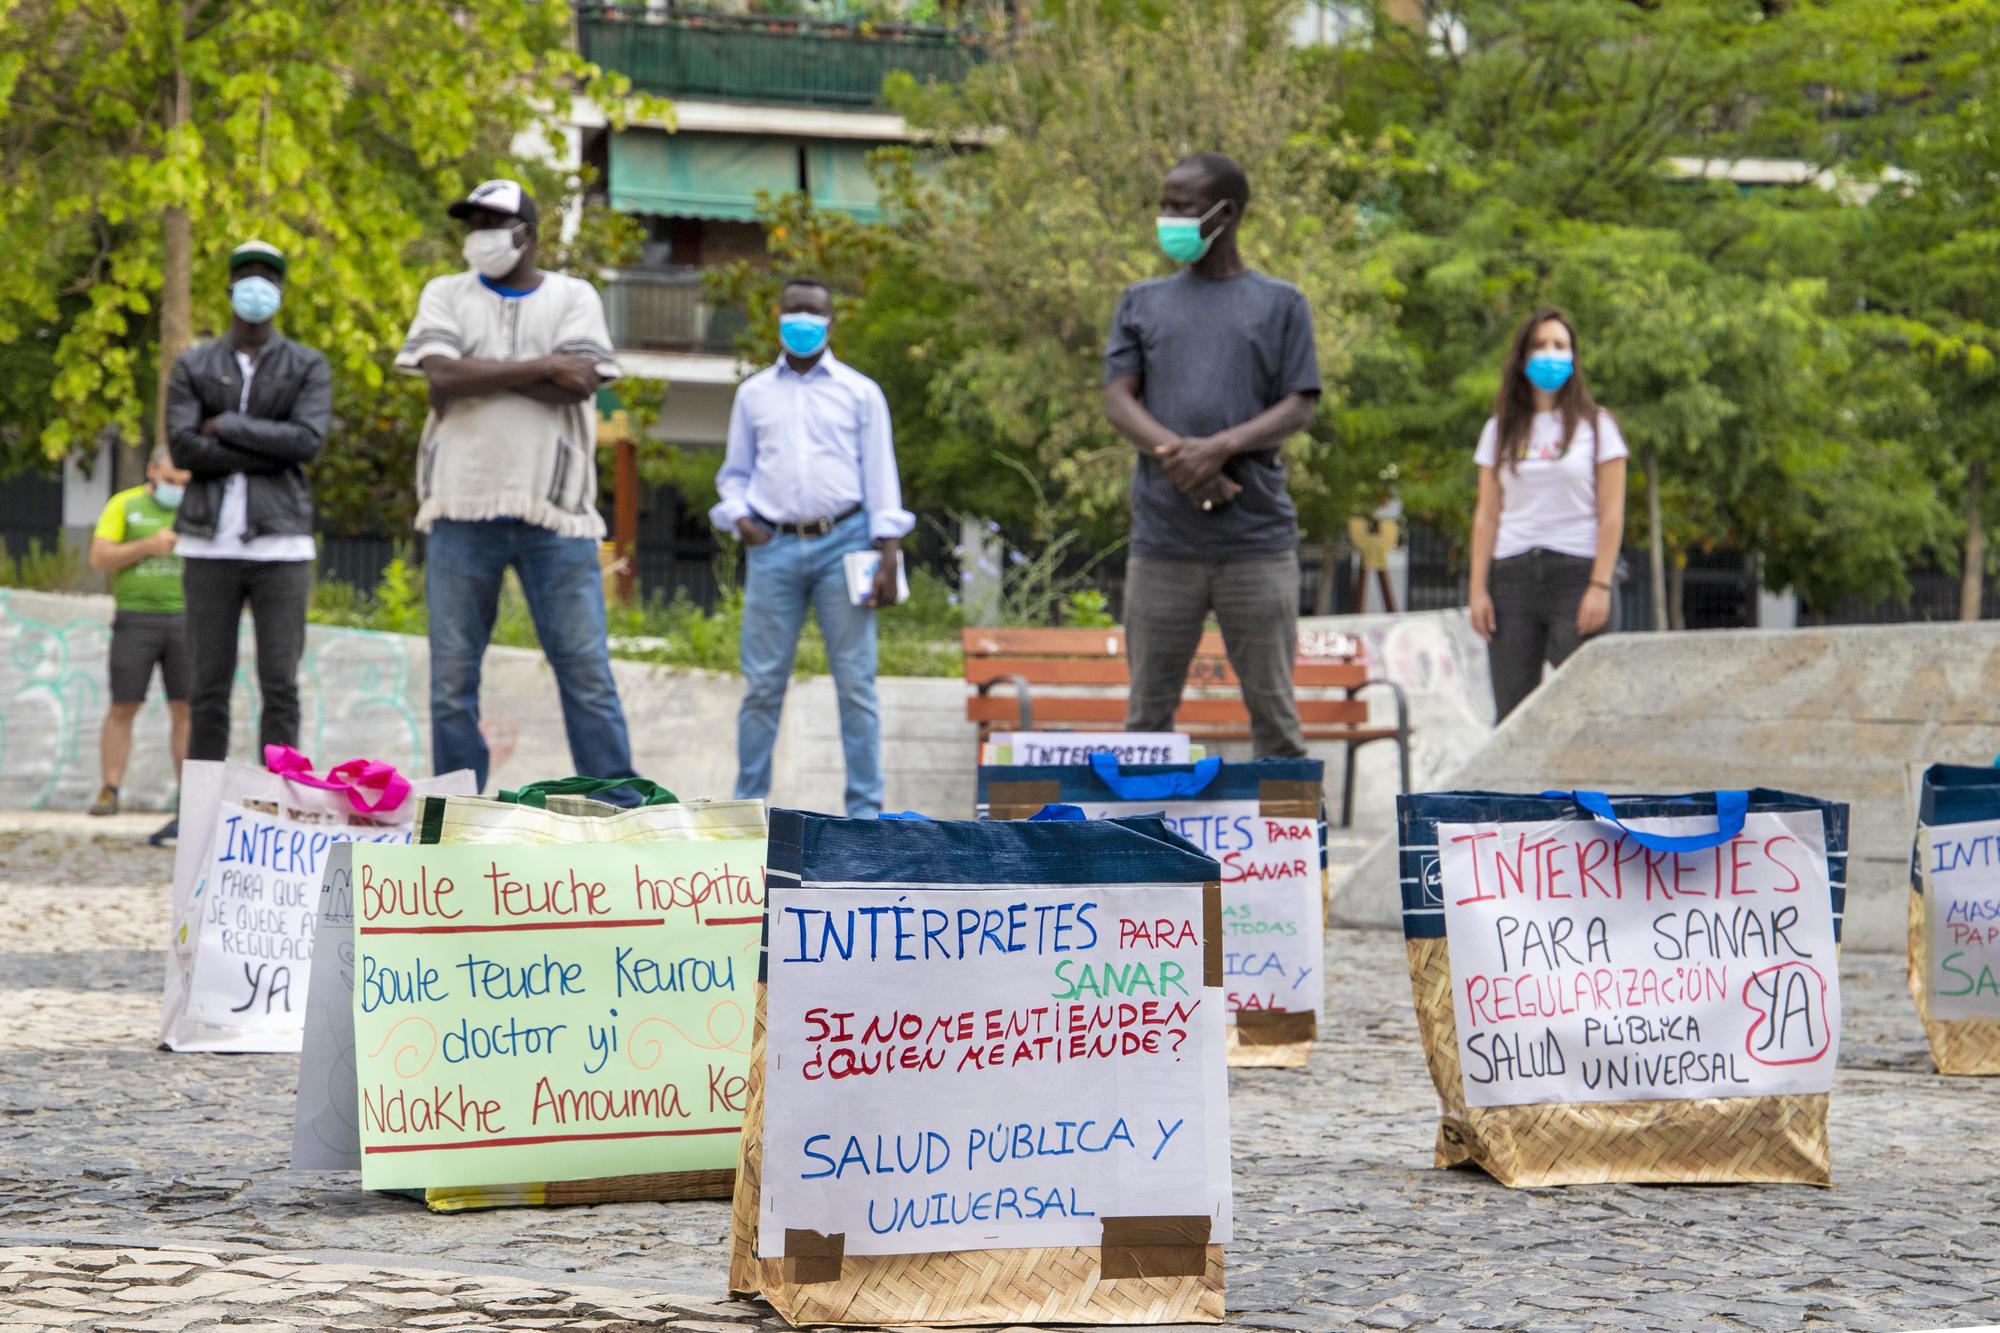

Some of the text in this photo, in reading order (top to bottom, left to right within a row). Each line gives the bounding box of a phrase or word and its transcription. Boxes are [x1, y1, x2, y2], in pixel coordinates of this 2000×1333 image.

[1264, 820, 1314, 844] PARA
[221, 868, 264, 901] PARA
[272, 878, 309, 908] QUE
[361, 864, 463, 921] Boule
[1218, 850, 1309, 884] SANAR
[1450, 830, 1802, 906] INTERPRETES
[207, 894, 227, 926] SE
[236, 904, 289, 936] QUEDE
[783, 897, 1199, 963] INTÉRPRETES PARA
[1495, 914, 1612, 974] PARA
[230, 960, 292, 1014] YA
[361, 953, 449, 1013] Boule
[1050, 959, 1192, 1001] SANAR
[1752, 969, 1815, 1052] YA
[442, 1007, 619, 1075] doctor yi
[1466, 1026, 1567, 1085] SALUD
[531, 1075, 691, 1127] Amouma
[800, 1116, 1184, 1181] SALUD PÚBLICA Y
